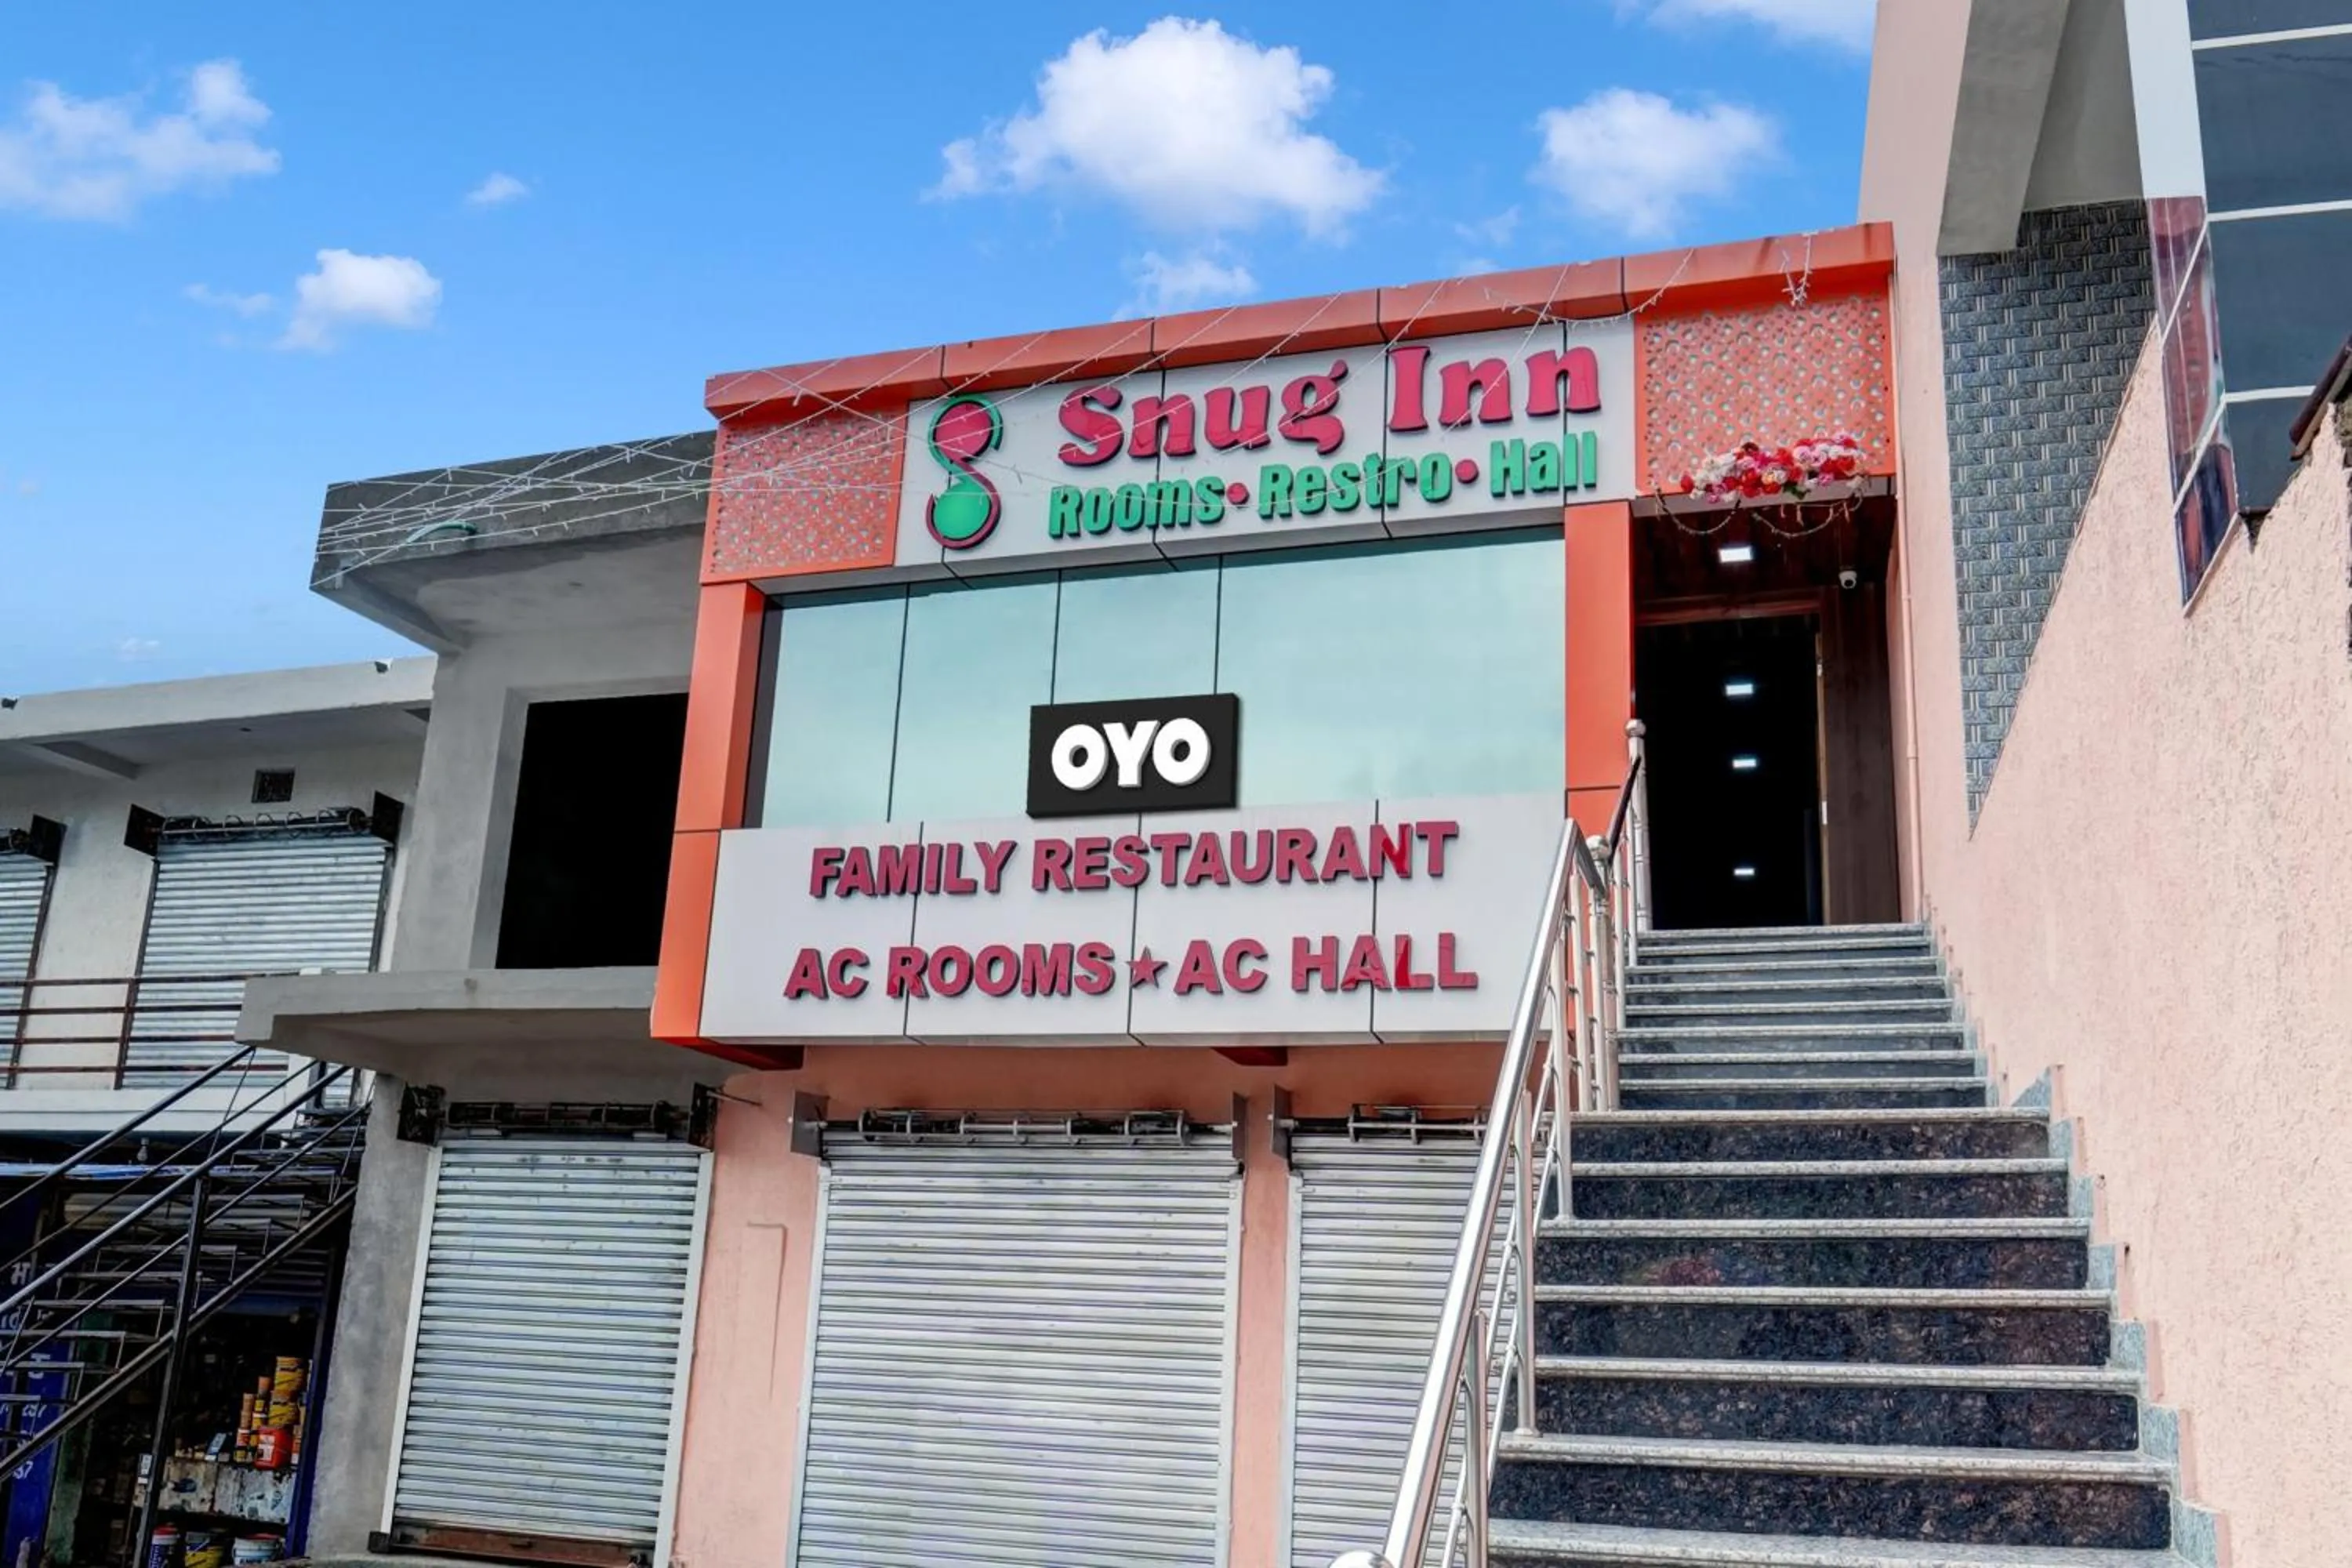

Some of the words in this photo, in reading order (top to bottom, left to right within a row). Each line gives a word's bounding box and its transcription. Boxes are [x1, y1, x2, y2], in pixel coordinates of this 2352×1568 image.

[1057, 358, 1348, 466] Snug
[1388, 345, 1602, 432] Inn
[1047, 476, 1225, 539] Rooms
[1258, 452, 1452, 519] Restro
[1490, 430, 1598, 498] Hall
[1051, 718, 1209, 789] OYO
[810, 840, 1017, 898] FAMILY
[1033, 821, 1457, 891] RESTAURANT
[784, 948, 868, 999] AC
[886, 942, 1115, 999] ROOMS
[1175, 938, 1266, 996] AC
[1292, 932, 1478, 993] HALL
